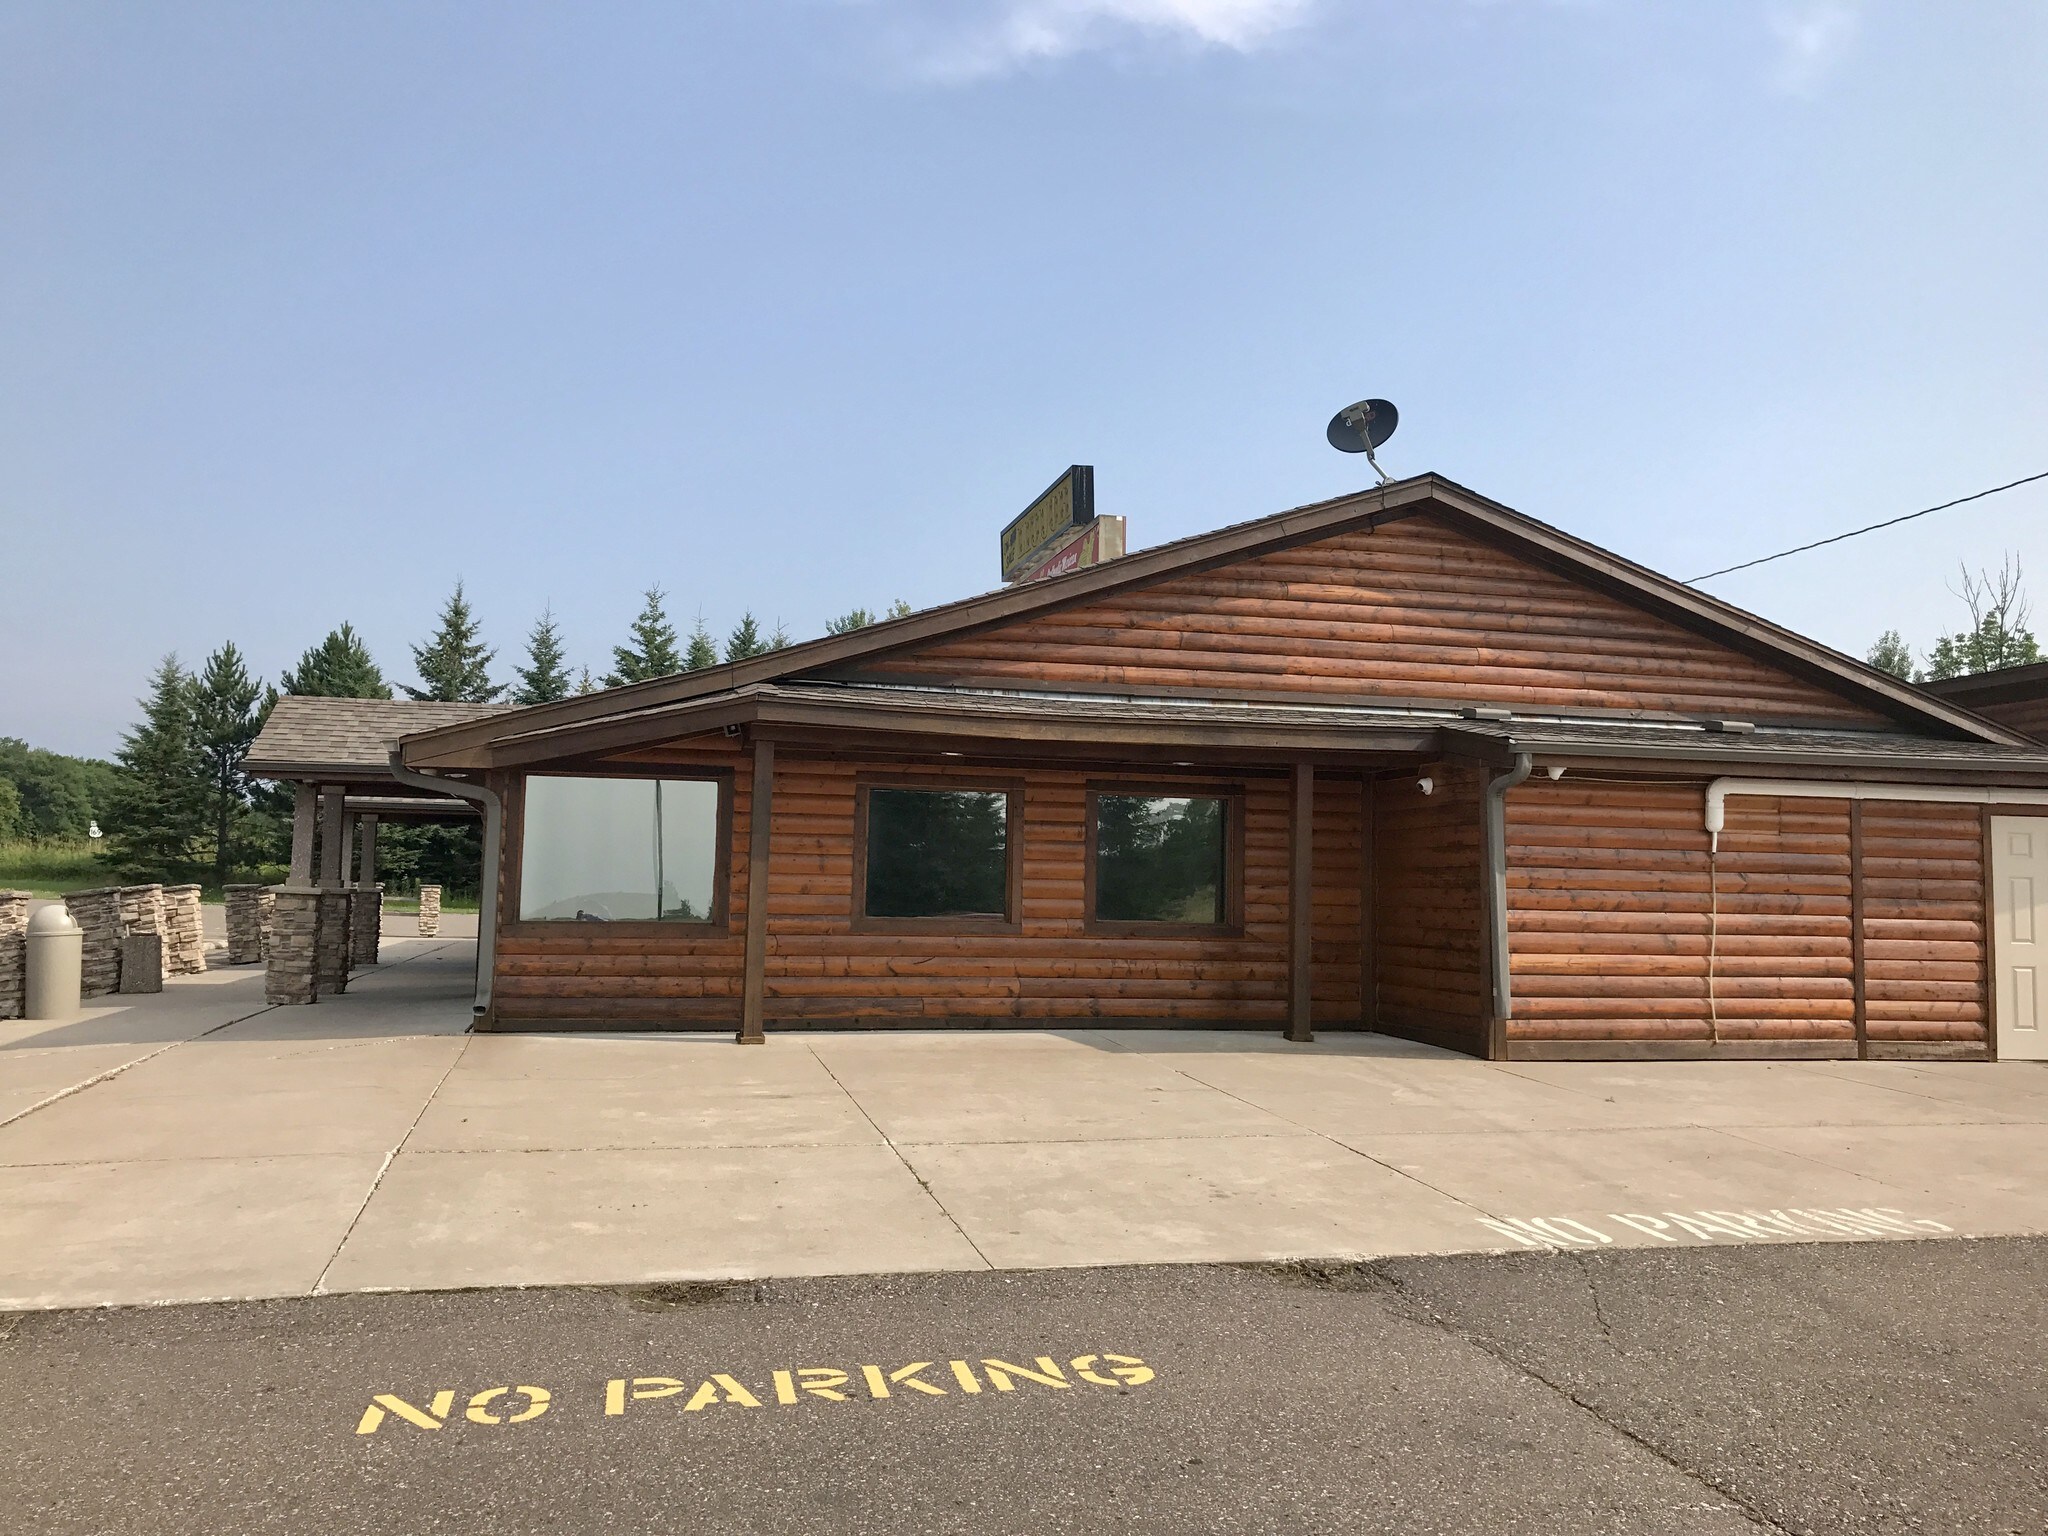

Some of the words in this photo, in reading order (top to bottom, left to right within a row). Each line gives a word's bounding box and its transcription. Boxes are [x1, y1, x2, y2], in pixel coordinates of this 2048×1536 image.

[1474, 1216, 1613, 1246] NO
[1606, 1207, 1955, 1242] PARKING
[356, 1383, 552, 1435] NO
[604, 1353, 1156, 1417] PARKING
